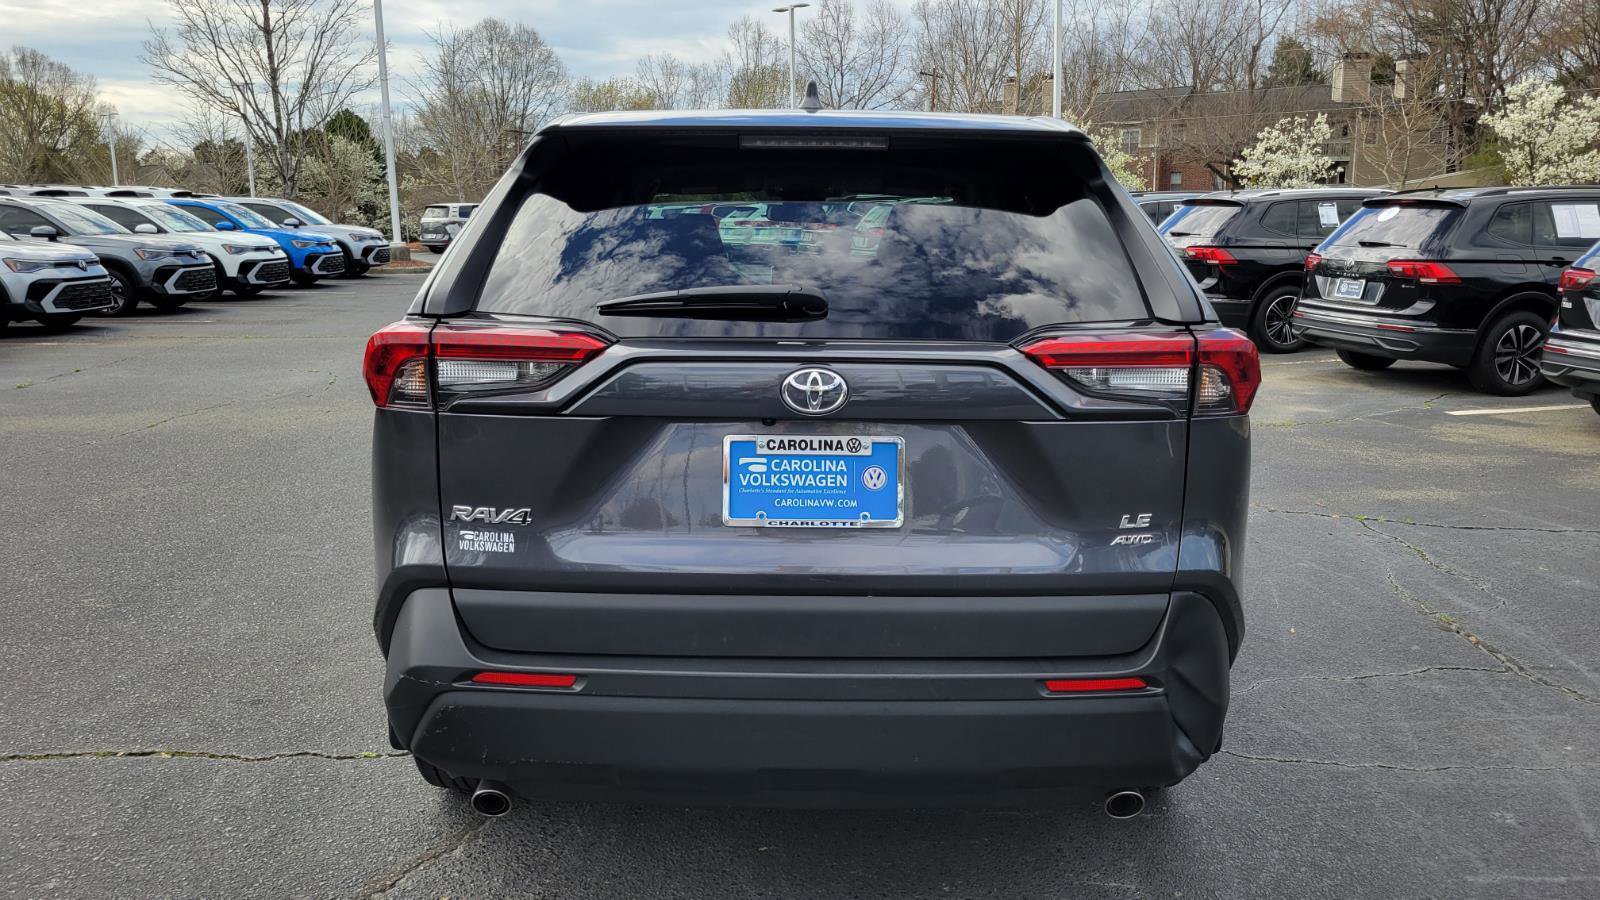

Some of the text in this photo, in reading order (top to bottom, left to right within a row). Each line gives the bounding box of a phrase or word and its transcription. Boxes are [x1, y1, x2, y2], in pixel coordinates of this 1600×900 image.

[766, 438, 844, 451] CAROLINA
[770, 459, 847, 472] CAROLINA
[739, 473, 848, 487] VOLKSWAGEN
[774, 498, 858, 508] CAROLINAVW.COM
[450, 505, 532, 526] RAV4
[1119, 513, 1152, 528] LE
[473, 531, 515, 543] CAROLINA
[1109, 534, 1153, 546] AWD
[459, 540, 515, 553] VOLKSWAGEN
